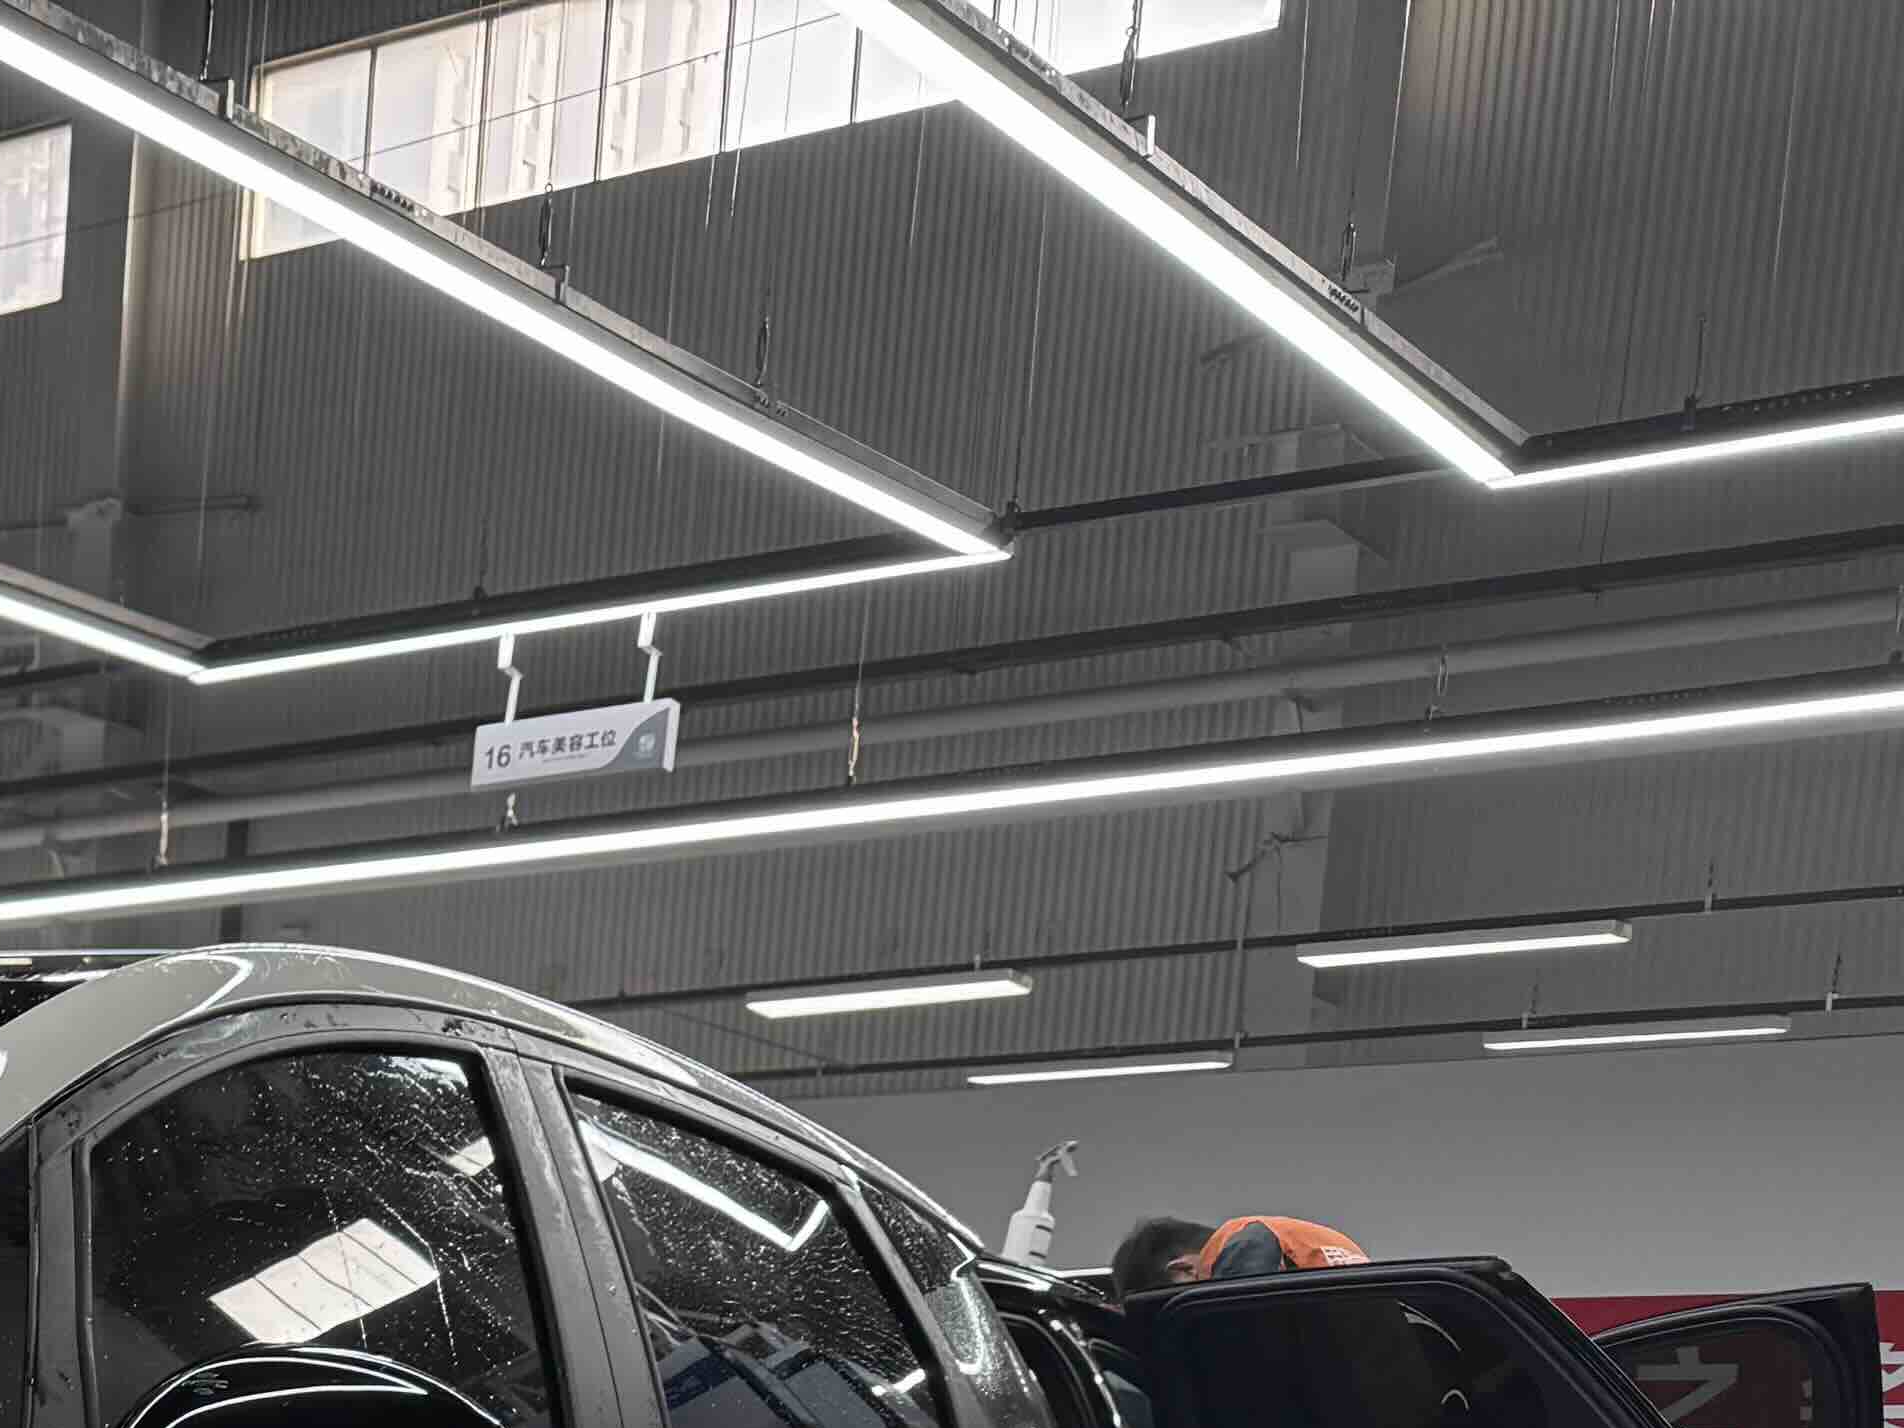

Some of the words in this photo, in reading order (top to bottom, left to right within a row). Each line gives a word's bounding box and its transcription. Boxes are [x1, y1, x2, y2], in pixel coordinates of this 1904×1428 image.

[485, 744, 511, 770] 16
[519, 729, 616, 759] 汽车美容工位
